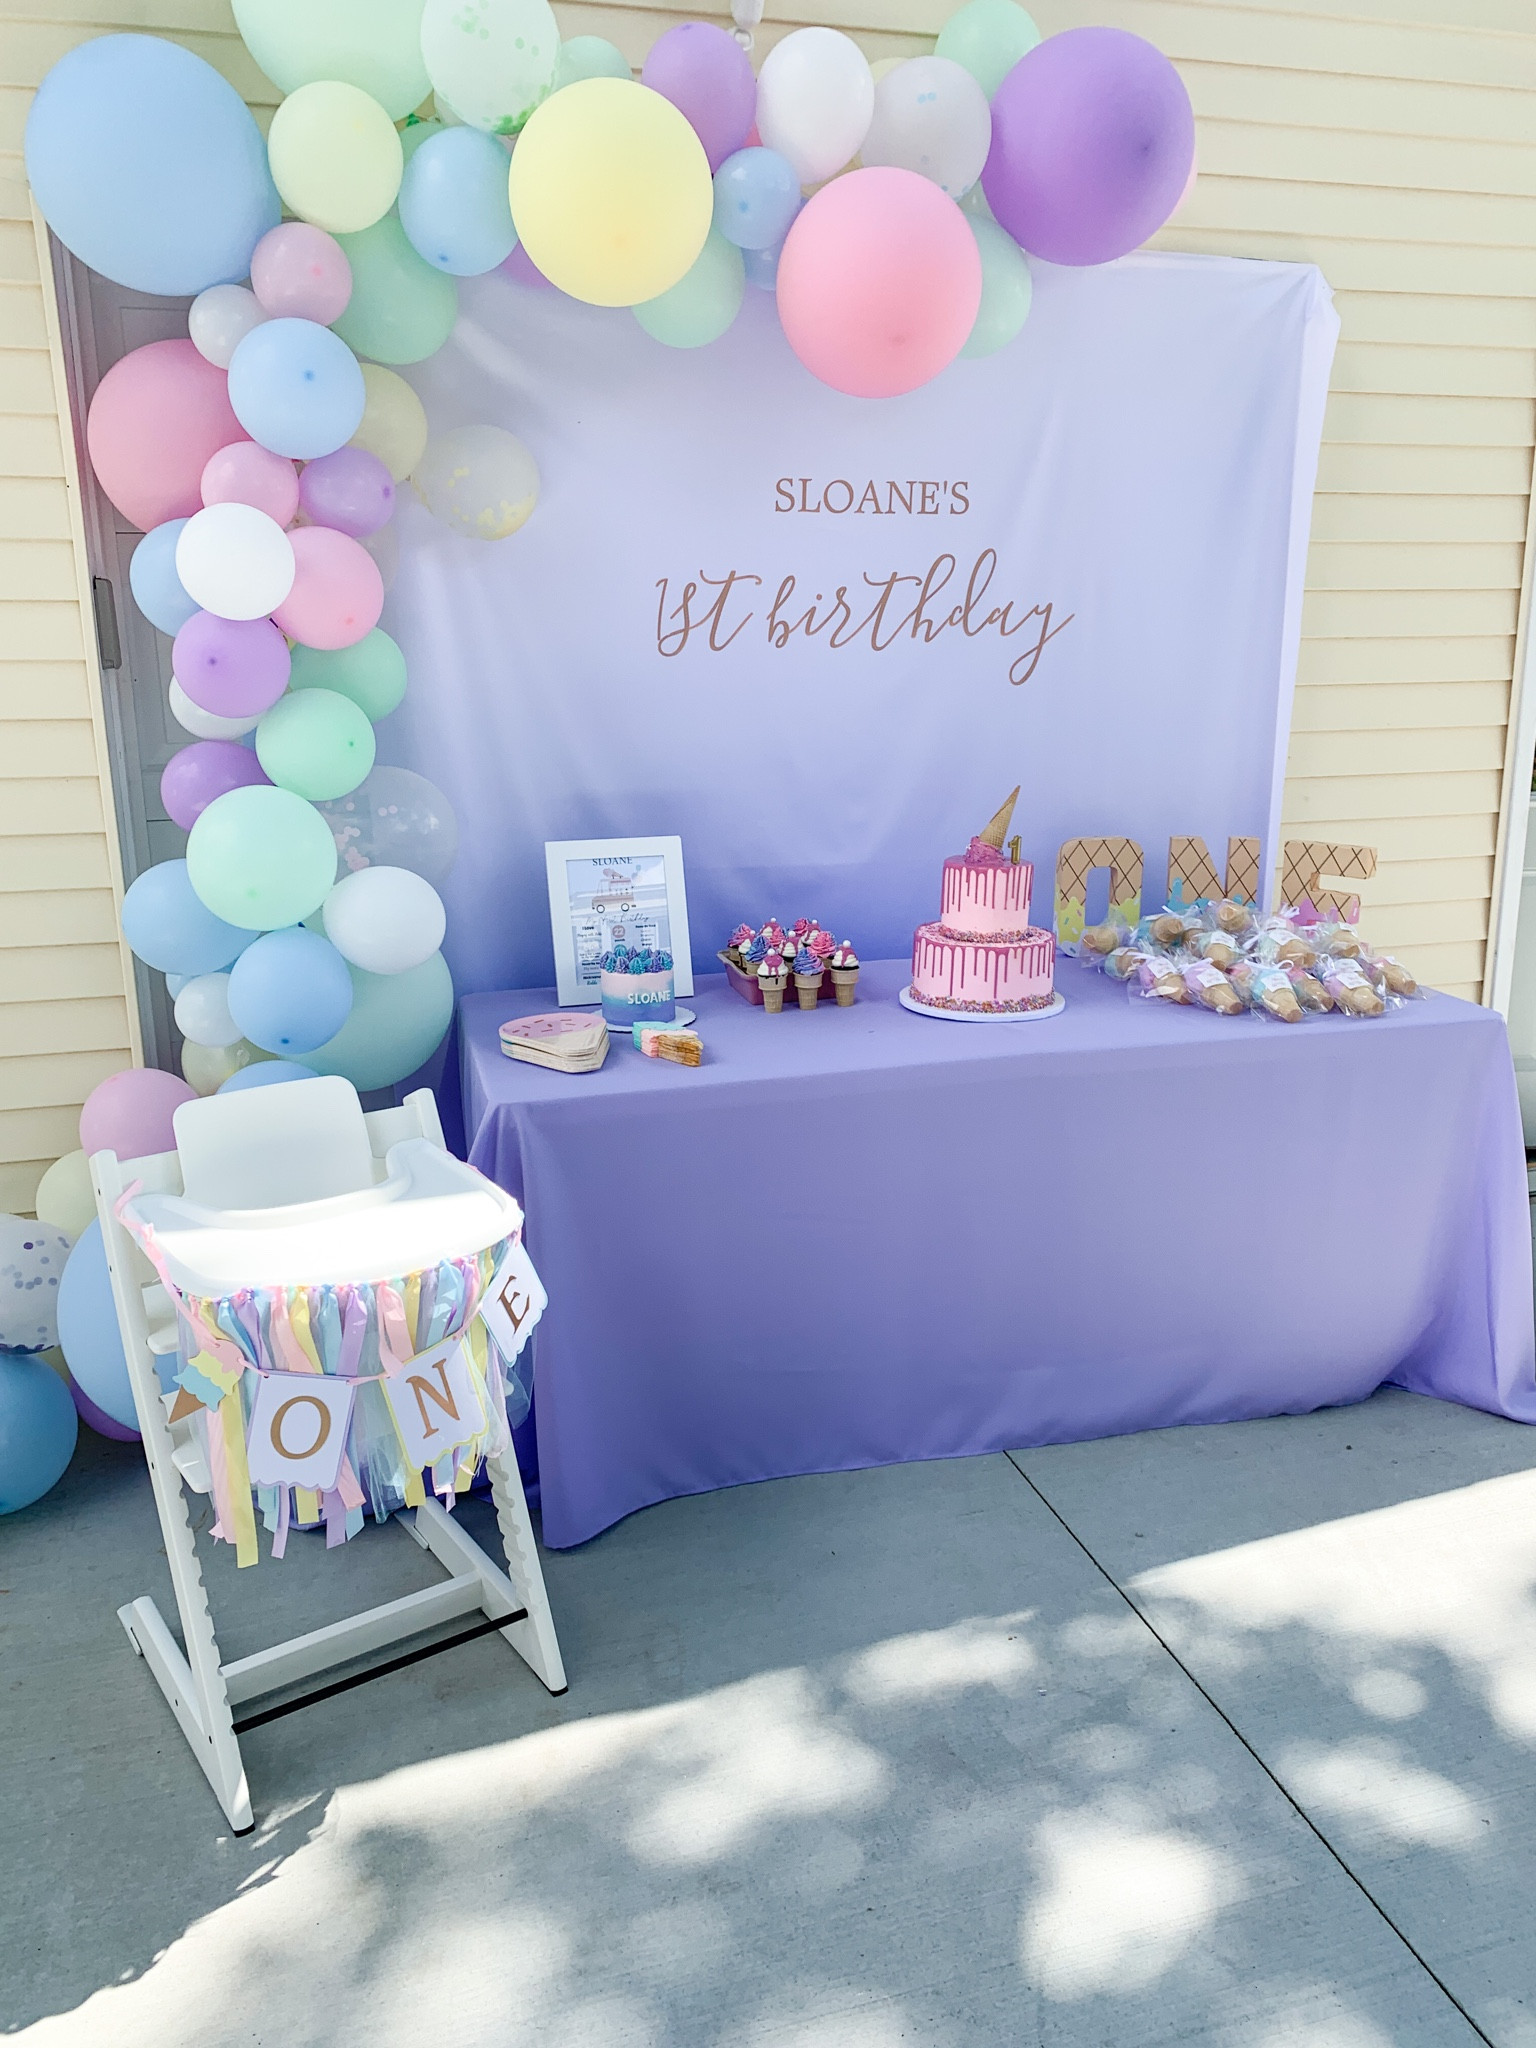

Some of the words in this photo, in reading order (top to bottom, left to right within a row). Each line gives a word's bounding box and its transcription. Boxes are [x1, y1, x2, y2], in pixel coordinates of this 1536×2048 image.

[775, 477, 970, 515] SLOANE'S
[766, 548, 1075, 686] birthday
[592, 856, 633, 866] SLOANE
[1008, 835, 1022, 865] 1
[1054, 836, 1378, 957] ONE
[627, 990, 671, 1004] SLOANE
